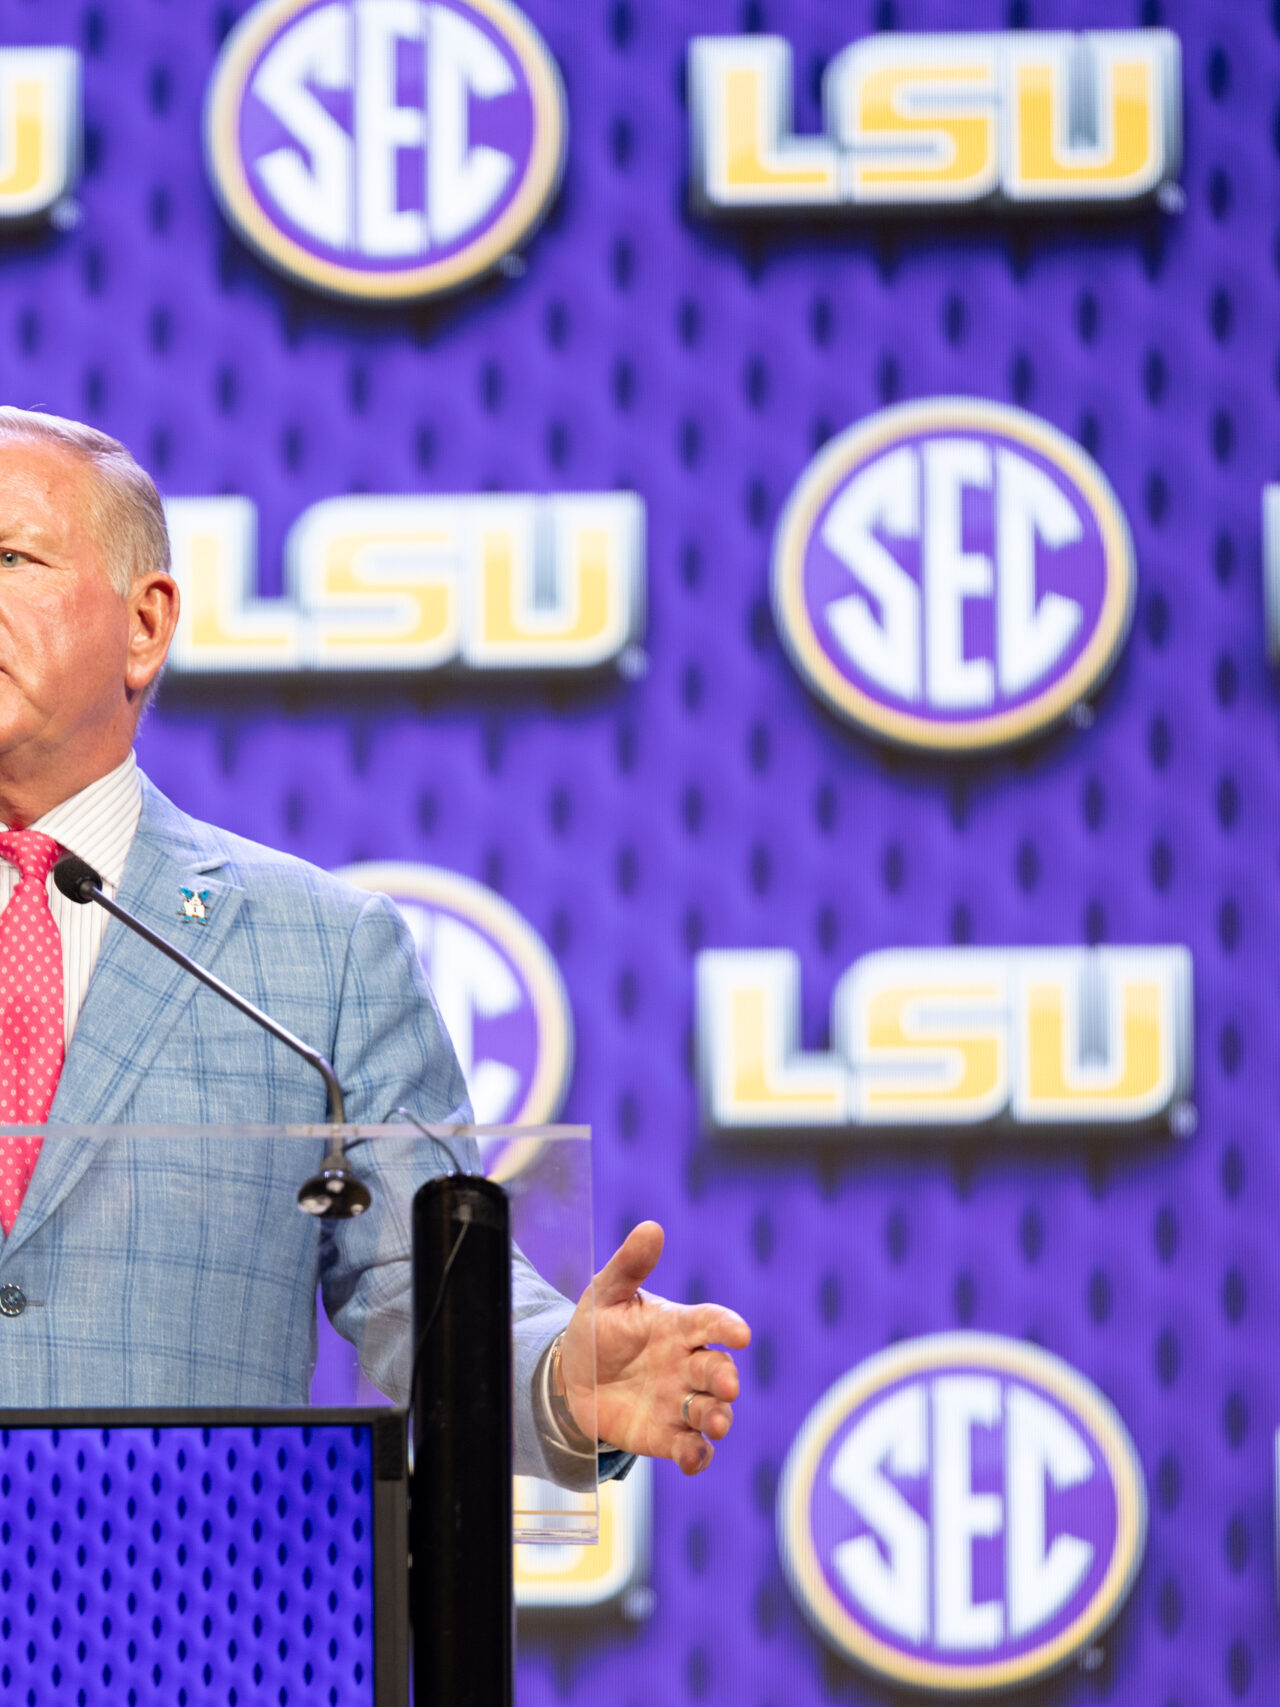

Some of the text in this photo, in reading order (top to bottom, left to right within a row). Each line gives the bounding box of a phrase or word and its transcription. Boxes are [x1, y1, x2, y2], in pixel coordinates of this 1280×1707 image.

[255, 0, 517, 258] SEC
[690, 30, 1183, 206] LSU
[166, 492, 646, 672] LSU
[823, 440, 1084, 708] SEC
[696, 945, 1193, 1126] LSU
[830, 1373, 1095, 1650] SEC
